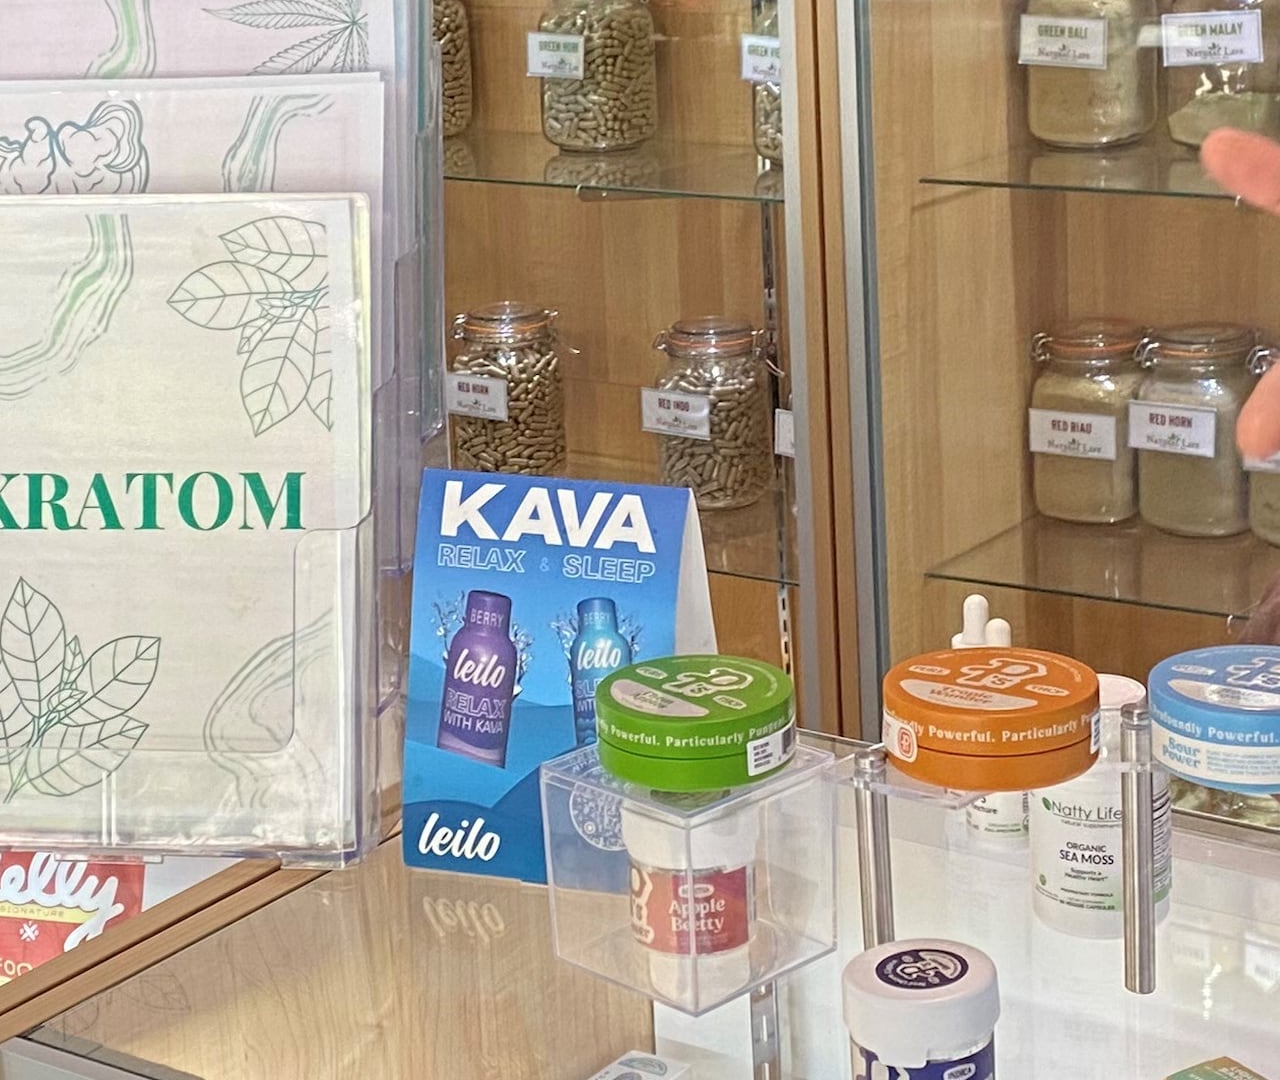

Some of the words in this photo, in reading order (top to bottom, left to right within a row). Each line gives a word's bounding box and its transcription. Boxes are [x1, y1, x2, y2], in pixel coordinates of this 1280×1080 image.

[1038, 24, 1065, 37] GREEN
[1068, 25, 1088, 39] BALI
[1209, 22, 1243, 36] MALAY
[458, 382, 470, 393] RED
[1051, 420, 1069, 433] RED
[1070, 421, 1093, 434] RIAU
[1149, 413, 1166, 427] RED
[1168, 414, 1193, 428] HORN
[439, 480, 657, 553] KAVA
[437, 544, 526, 573] RELAX
[539, 557, 550, 572] &
[563, 555, 656, 584] SLEEP
[470, 609, 505, 628] BERRY
[576, 642, 622, 670] leilo
[453, 648, 506, 689] leilo
[445, 688, 506, 719] RELAX
[443, 715, 472, 731] WITH
[475, 718, 505, 734] KAVA
[929, 726, 996, 743] Powerful.
[1002, 720, 1079, 742] Particularly
[1150, 704, 1202, 737] Profoundly
[1208, 726, 1279, 744] Powerful.
[610, 724, 660, 746] Powerful.
[666, 732, 744, 748] Particularly
[1162, 746, 1202, 769] Power
[1168, 737, 1201, 758] Sour
[1052, 800, 1092, 820] Natty
[1097, 801, 1124, 820] Life
[418, 813, 502, 862] leilo
[1066, 841, 1107, 853] ORGANIC
[1059, 849, 1079, 863] SEA
[1081, 853, 1115, 865] MOSS
[0, 904, 65, 918] SIGNATURE
[669, 899, 726, 918] Apple
